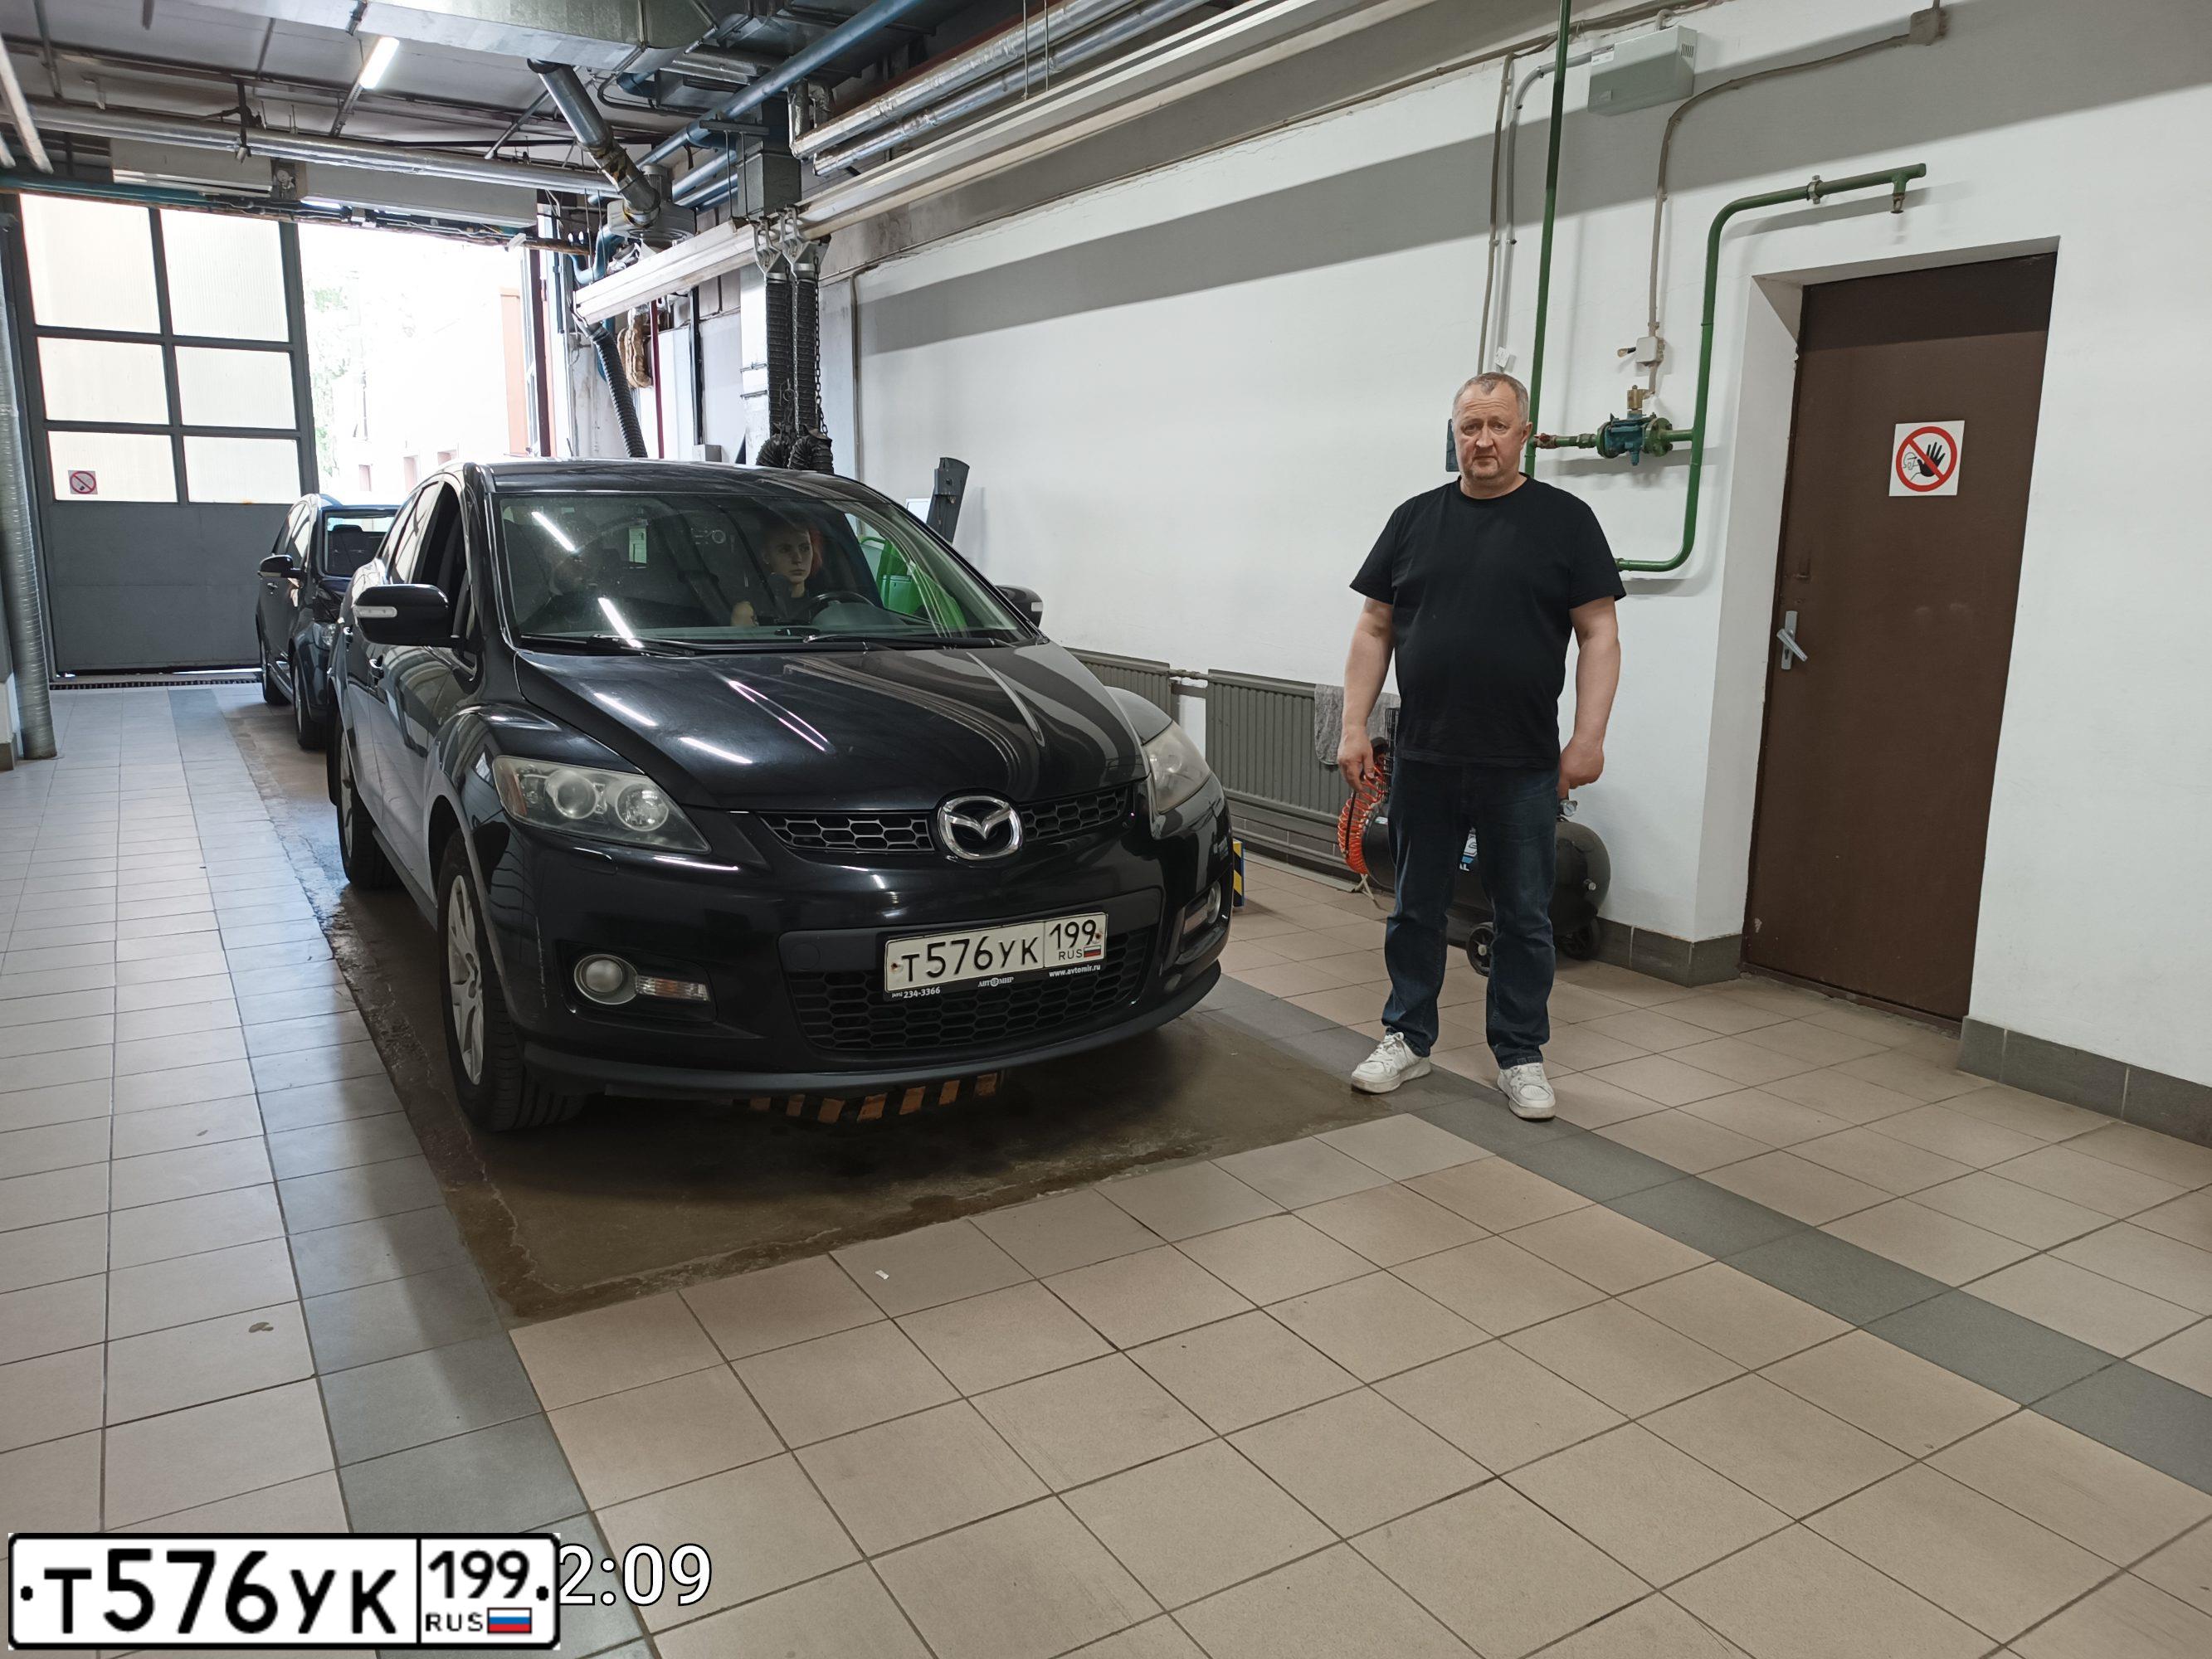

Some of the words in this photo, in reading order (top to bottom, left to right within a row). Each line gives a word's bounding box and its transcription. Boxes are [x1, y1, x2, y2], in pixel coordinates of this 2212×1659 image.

[900, 936, 1039, 983] Т576УК
[1049, 919, 1098, 951] 199
[1058, 949, 1083, 961] RUS
[1049, 964, 1101, 977] www.avtomir.ru
[903, 985, 941, 1000] 234-3366
